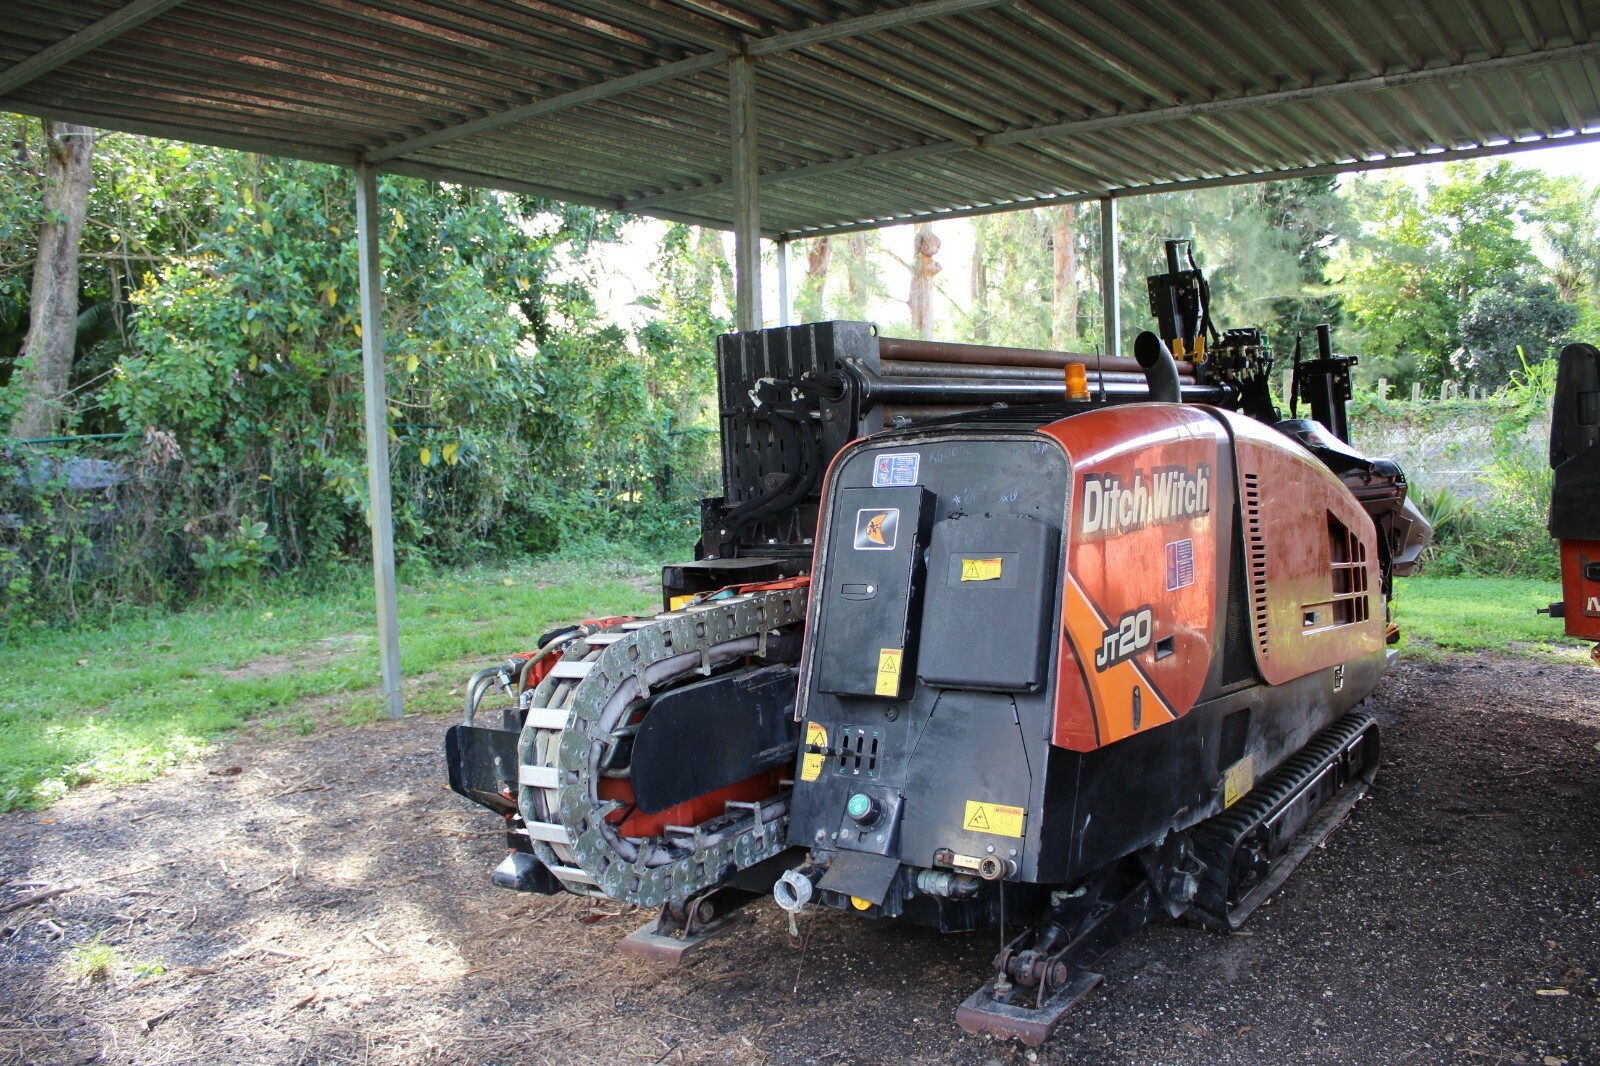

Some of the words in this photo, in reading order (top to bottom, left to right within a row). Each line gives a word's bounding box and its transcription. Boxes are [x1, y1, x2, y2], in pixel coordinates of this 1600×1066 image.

[1082, 475, 1147, 533] Ditch
[1153, 468, 1208, 519] Witch
[1096, 609, 1152, 667] JT20
